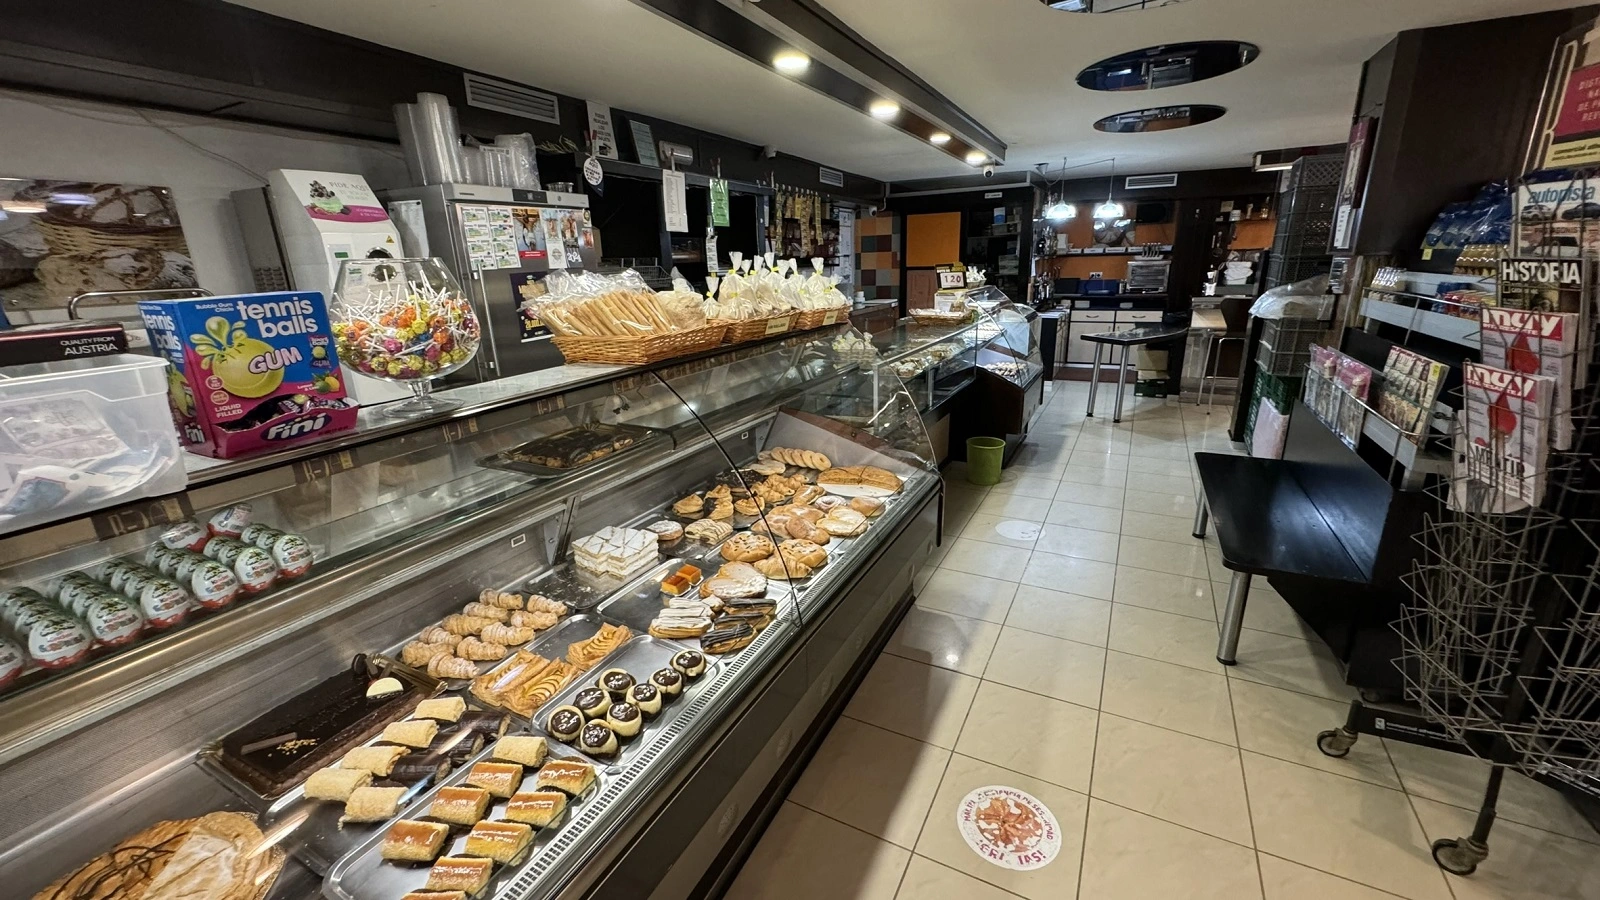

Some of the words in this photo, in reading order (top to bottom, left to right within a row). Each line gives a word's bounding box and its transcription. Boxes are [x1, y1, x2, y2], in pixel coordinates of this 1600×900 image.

[1528, 184, 1596, 205] autopista
[1502, 261, 1580, 284] HISTORIA
[141, 305, 176, 331] tennis
[236, 297, 314, 321] tennis
[258, 316, 319, 338] balls
[60, 336, 93, 346] QUALITY
[93, 335, 116, 343] FROM
[64, 342, 118, 356] AUSTRIA
[153, 330, 182, 351] balls
[248, 347, 303, 374] GUM
[1466, 365, 1536, 397] muy
[214, 403, 241, 412] LIQUID
[216, 409, 243, 418] FILLED
